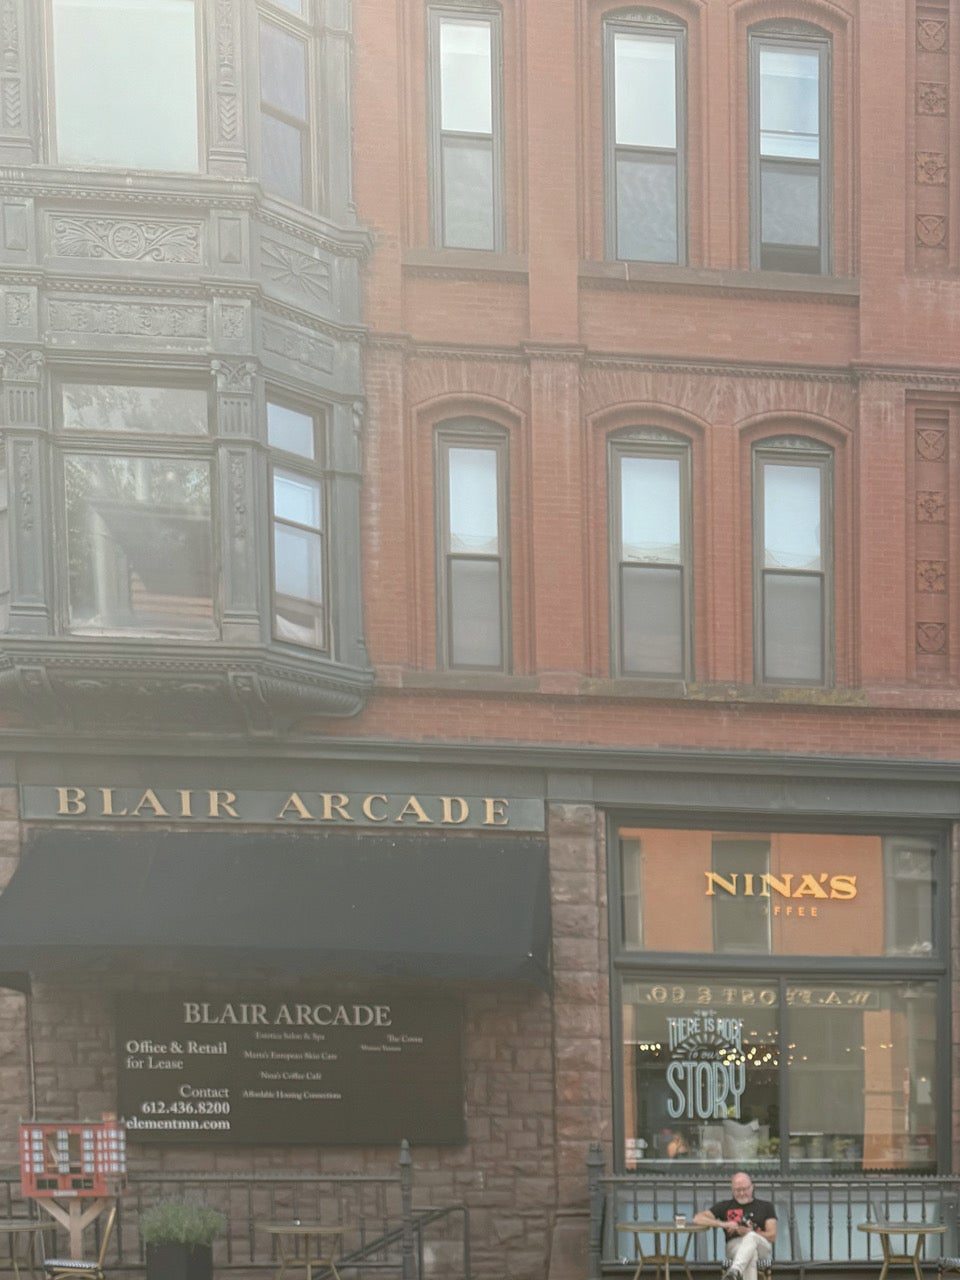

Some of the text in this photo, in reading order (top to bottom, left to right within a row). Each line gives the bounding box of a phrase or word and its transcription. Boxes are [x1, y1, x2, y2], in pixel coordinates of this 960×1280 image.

[56, 787, 511, 825] BLAIR ARCADE
[704, 871, 858, 900] NINA'S
[758, 906, 818, 917] FFEE
[183, 1003, 393, 1027] BLAIR ARCADE
[666, 1017, 701, 1051] THERE
[704, 1017, 715, 1033] IS
[126, 1040, 228, 1055] Office & Retail
[126, 1056, 184, 1070] for Lease
[180, 1083, 230, 1098] Contact
[666, 1061, 746, 1119] STORY
[142, 1101, 231, 1115] 612.436.8200
[125, 1116, 231, 1130] elementmn.com
